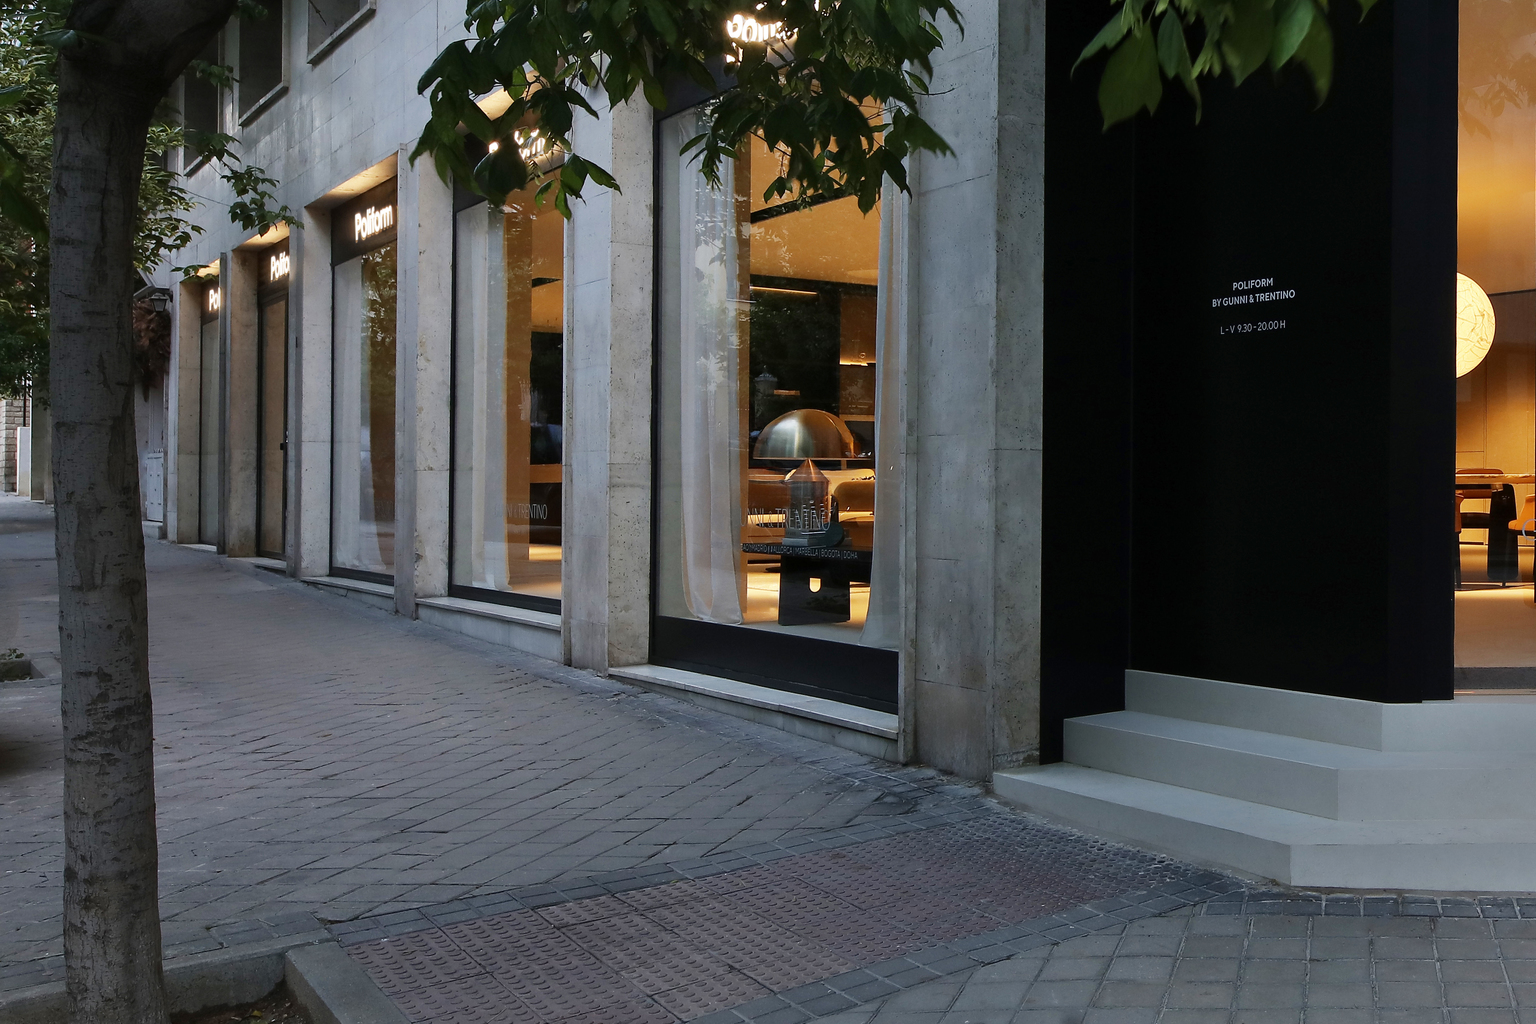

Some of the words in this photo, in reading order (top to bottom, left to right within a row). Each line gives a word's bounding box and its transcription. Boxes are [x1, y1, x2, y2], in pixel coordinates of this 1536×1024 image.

[354, 204, 393, 243] Poliform
[270, 251, 291, 282] Polifo
[1232, 277, 1274, 291] POLIFORM
[1212, 298, 1222, 308] BY
[1222, 295, 1248, 307] GUNNI
[1248, 294, 1255, 303] &
[1255, 289, 1296, 303] TRENTINO
[1220, 326, 1225, 335] L
[1229, 325, 1235, 334] V
[1237, 322, 1253, 333] 9.30
[1257, 320, 1279, 332] 20.00
[1280, 320, 1286, 329] H
[518, 503, 548, 520] TRENTINO
[775, 507, 832, 531] TRENTINO
[795, 547, 818, 557] MARBELLA
[821, 549, 841, 558] BOGOTA
[843, 551, 858, 559] DOHA
